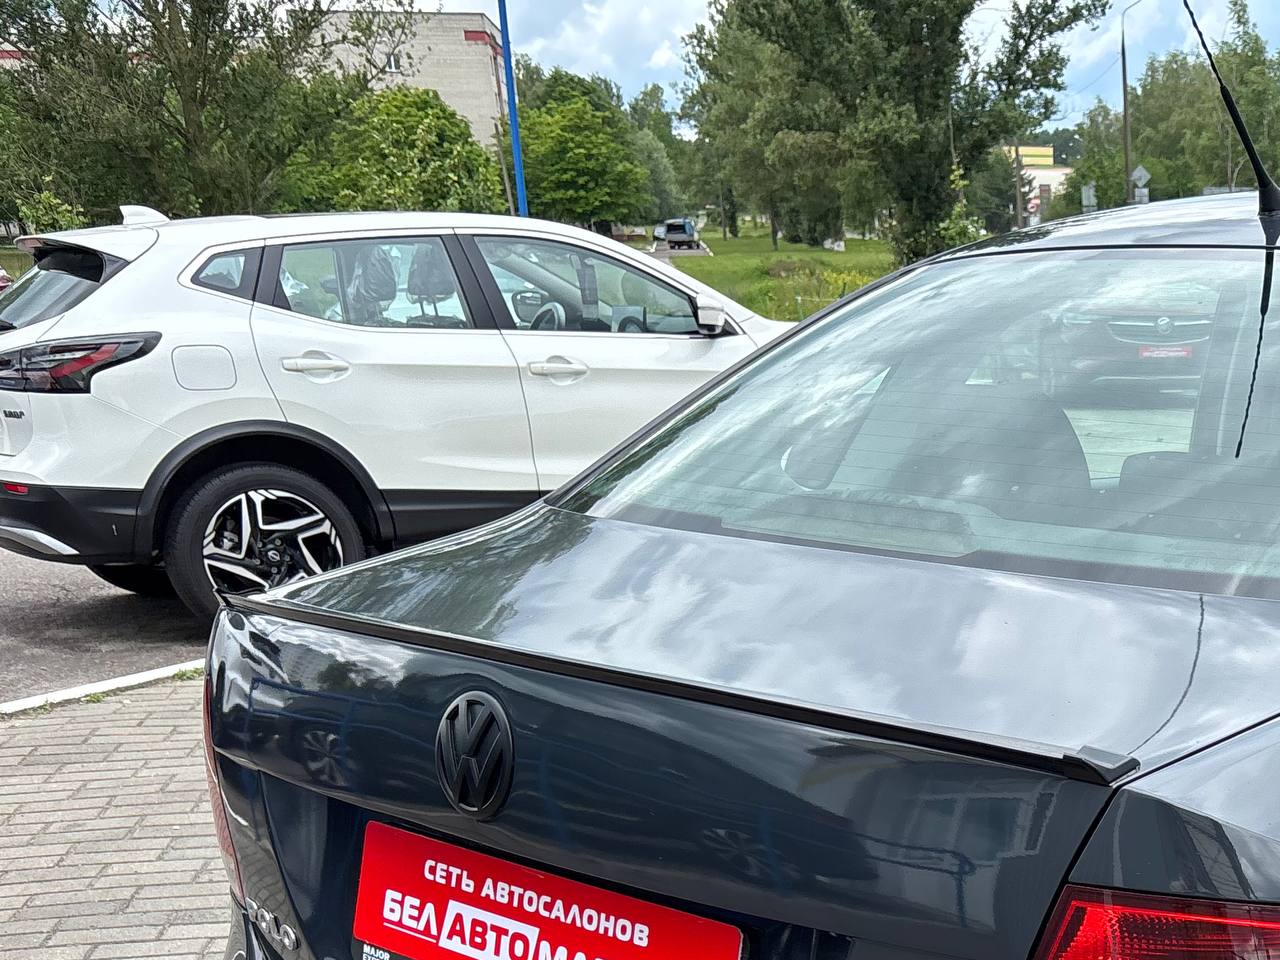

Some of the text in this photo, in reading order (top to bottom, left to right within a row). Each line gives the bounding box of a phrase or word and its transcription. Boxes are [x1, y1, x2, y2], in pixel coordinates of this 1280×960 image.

[424, 859, 650, 948] СЕТЬ АВТОСАЛОНОВ
[363, 944, 390, 960] MAJOR
